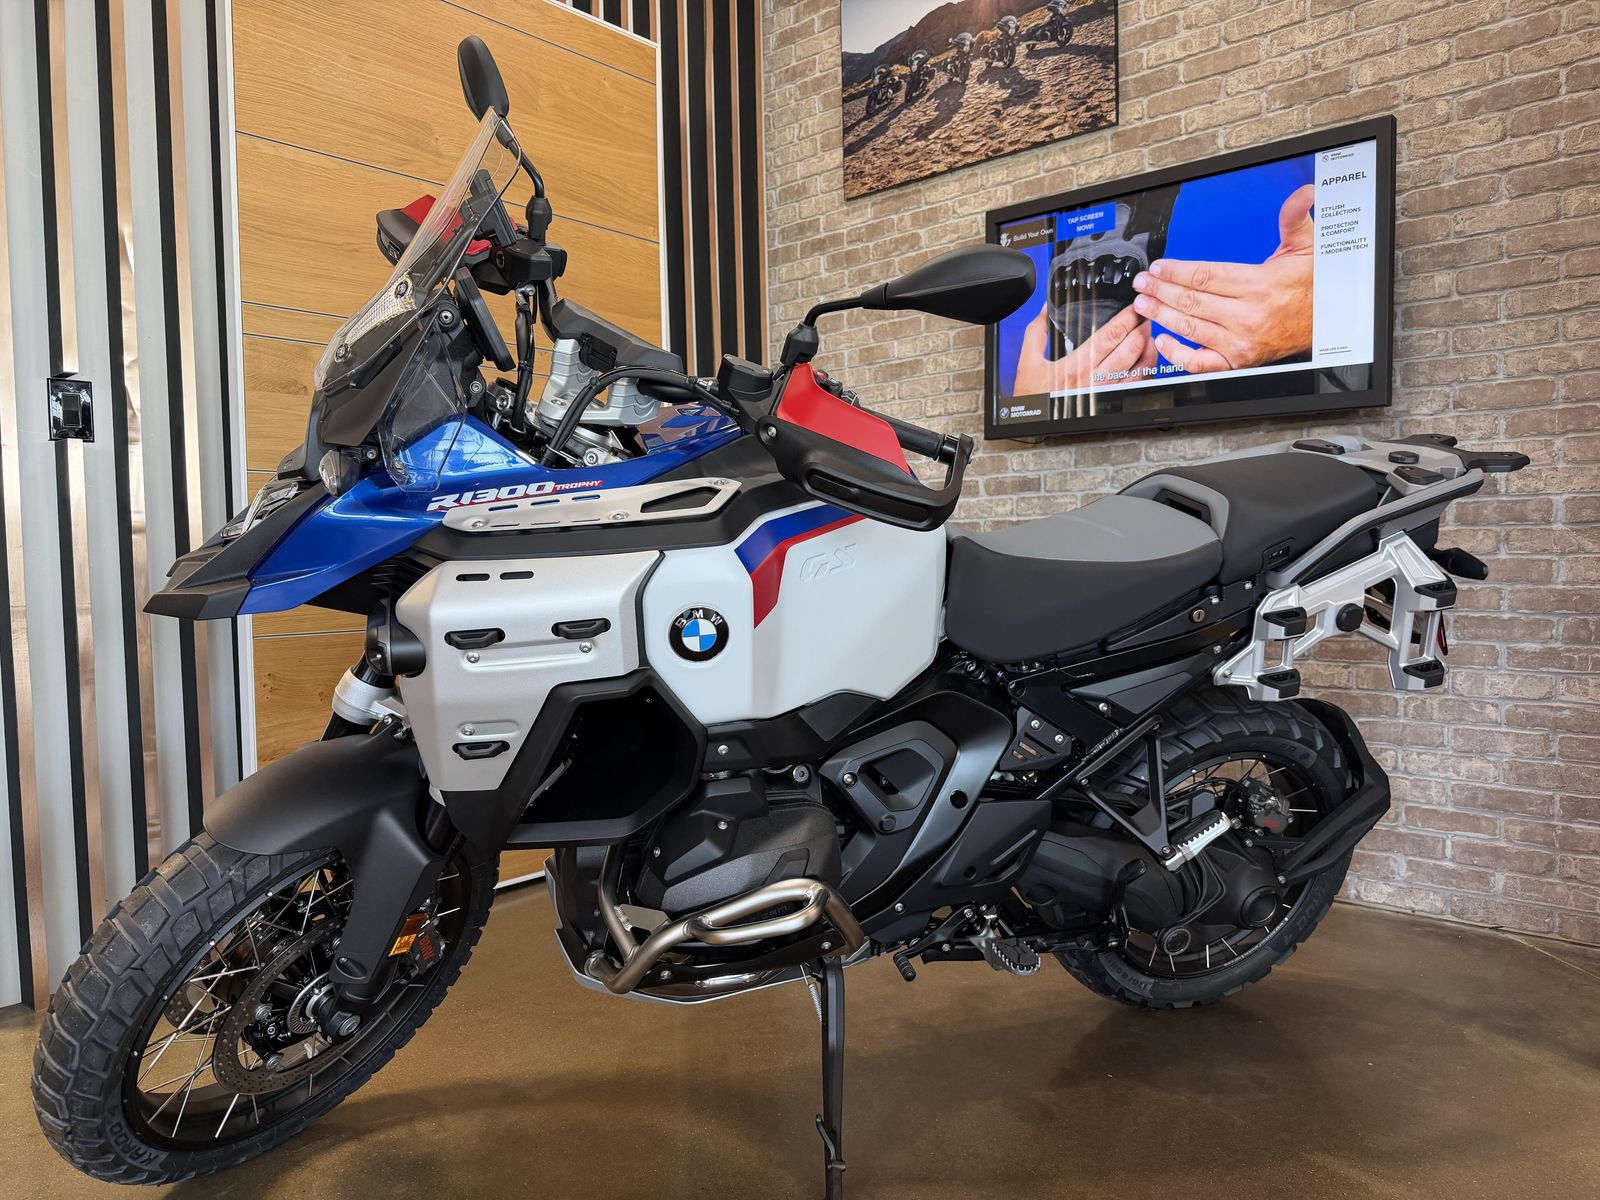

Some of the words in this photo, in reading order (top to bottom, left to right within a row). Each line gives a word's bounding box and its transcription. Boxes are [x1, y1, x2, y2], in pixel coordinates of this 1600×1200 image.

[1321, 171, 1367, 187] APPAREL
[1321, 204, 1345, 213] STYLISH
[1321, 207, 1361, 219] COLLECTIONS
[1067, 216, 1079, 225] TAP
[1079, 211, 1104, 222] SCREEN
[1076, 223, 1094, 233] NOW!
[1321, 220, 1359, 231] PROTECTION
[1013, 234, 1027, 242] Build
[1027, 231, 1039, 239] Your
[1040, 228, 1054, 236] Own
[1326, 227, 1355, 237] COMFORT
[1320, 237, 1367, 249] FUNCTIONALITY
[1325, 246, 1352, 255] MODERN
[1352, 243, 1369, 251] TECH
[1107, 369, 1129, 380] back
[1131, 368, 1140, 377] of
[1143, 366, 1158, 376] the
[1160, 363, 1184, 374] hand
[1010, 409, 1042, 418] MOTORRAD
[555, 480, 602, 491] TROPHY
[799, 542, 857, 583] GS
[675, 609, 723, 629] BMW
[108, 1122, 159, 1166] KAROO
